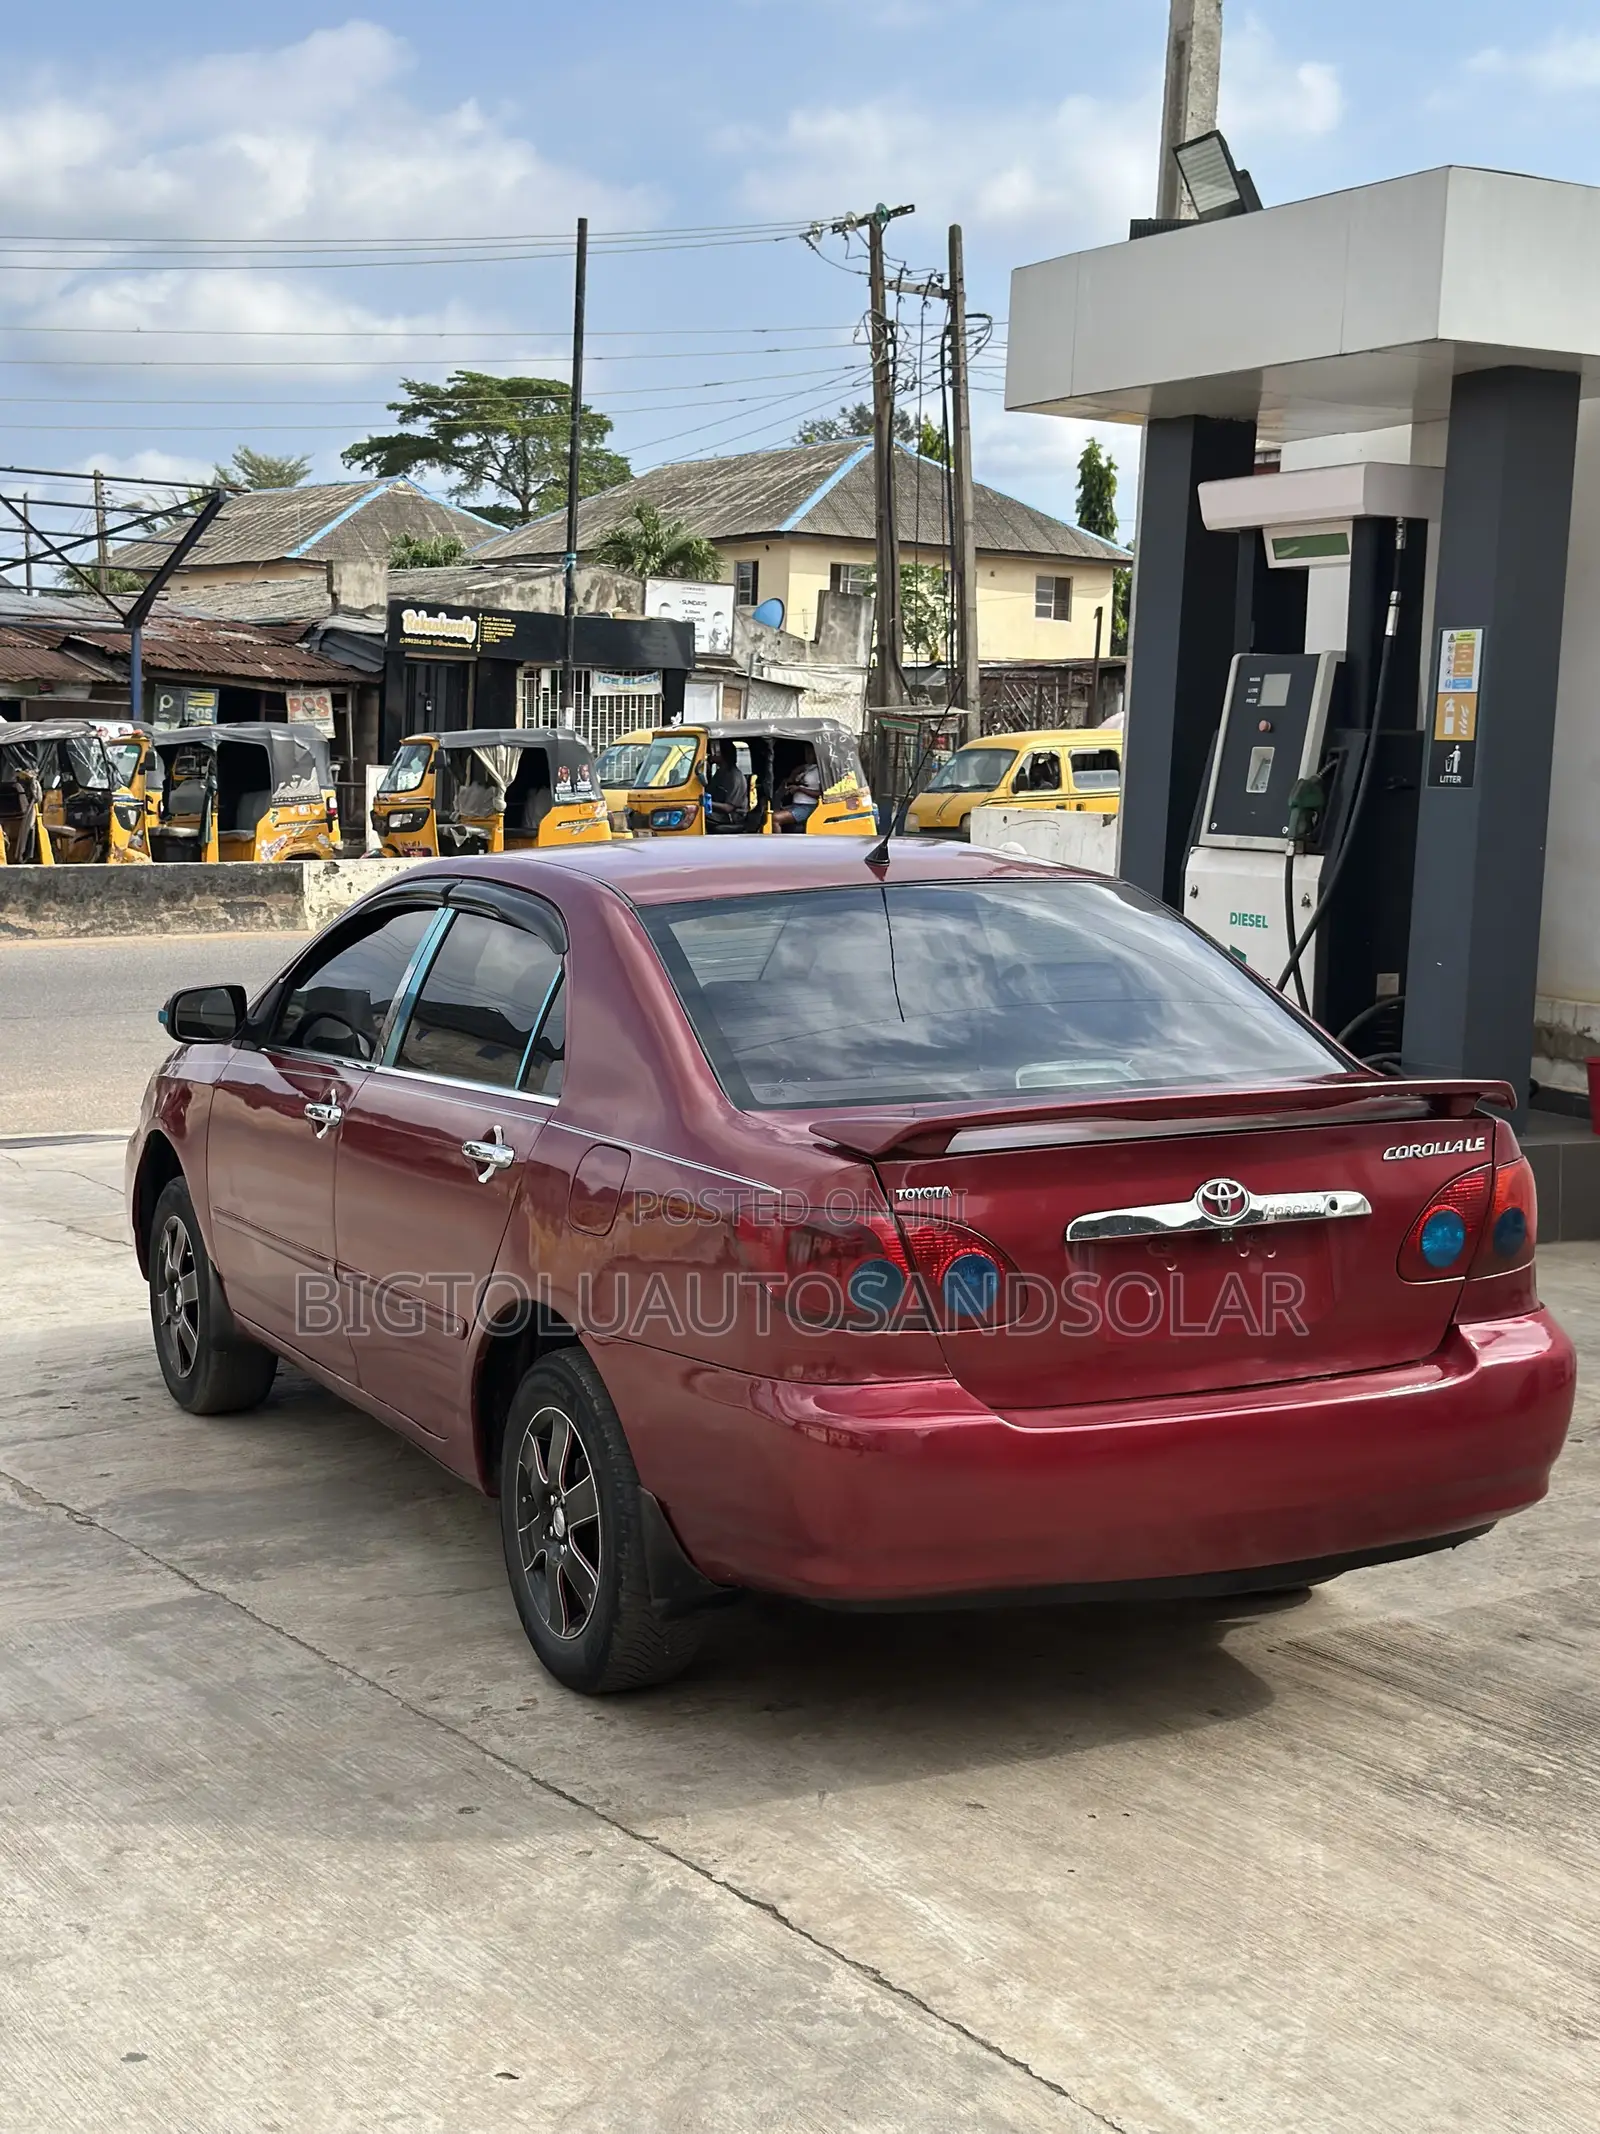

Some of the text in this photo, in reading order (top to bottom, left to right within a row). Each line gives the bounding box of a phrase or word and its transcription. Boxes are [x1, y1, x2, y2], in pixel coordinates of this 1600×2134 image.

[598, 675, 619, 685] ICE
[289, 696, 329, 719] POS
[1439, 775, 1461, 784] LITTER
[1230, 912, 1268, 928] DIESEL
[896, 1186, 953, 1200] TOYOTA
